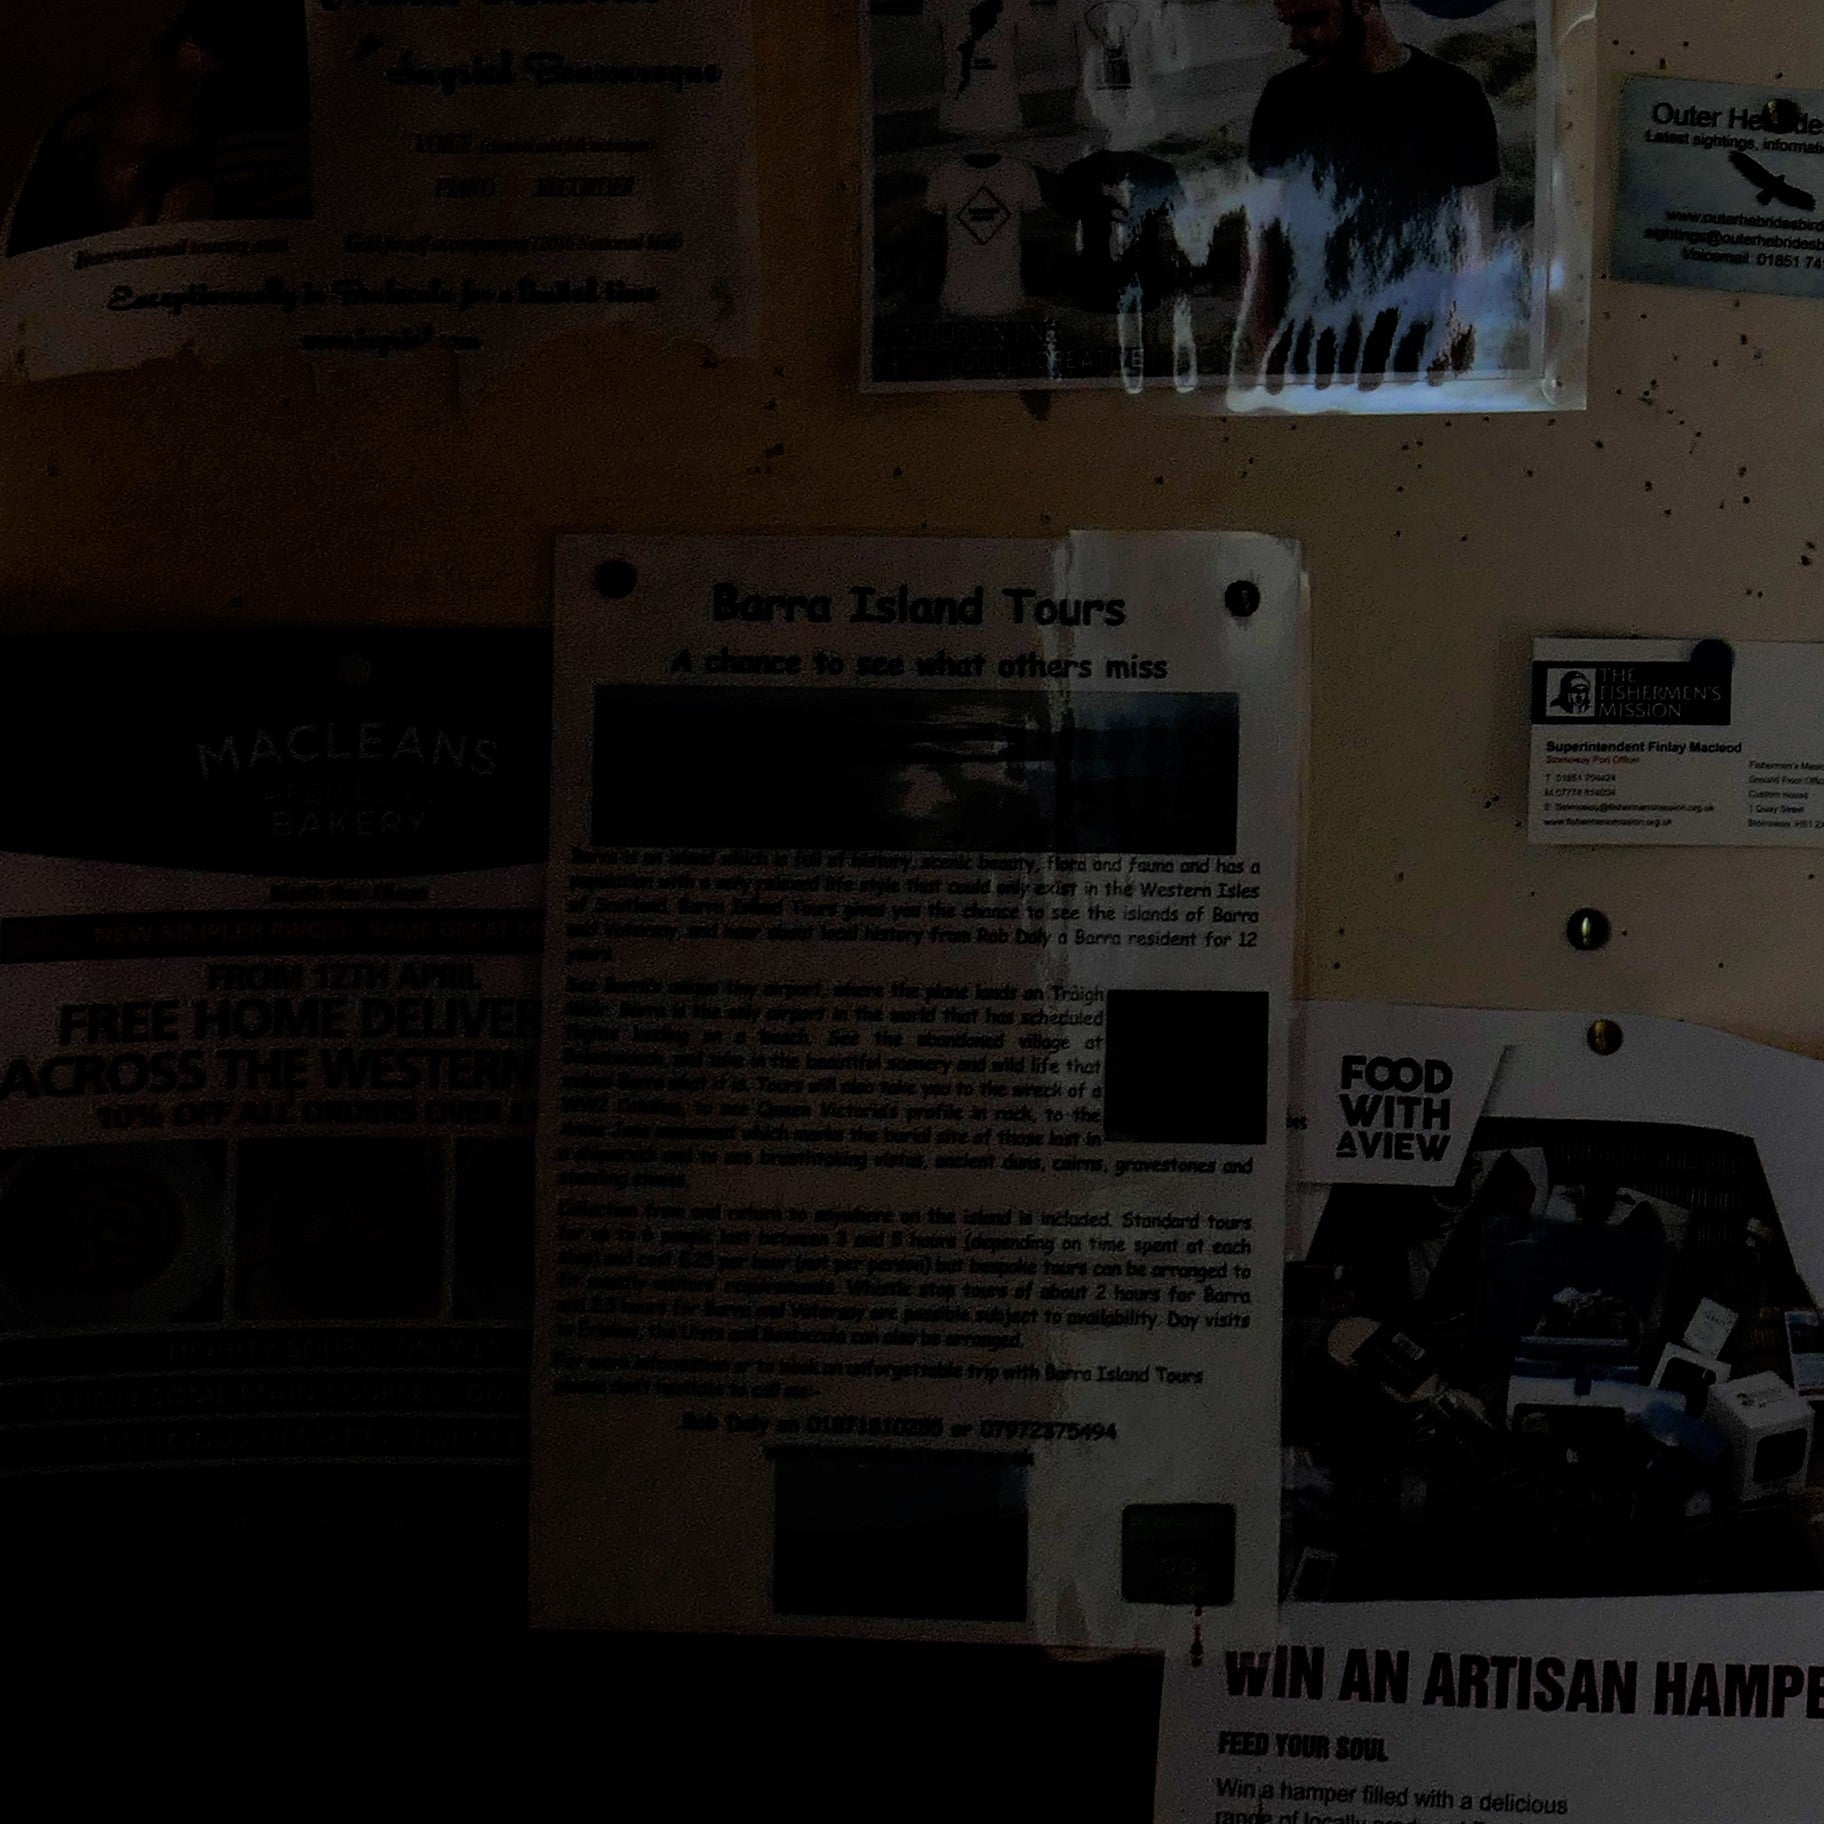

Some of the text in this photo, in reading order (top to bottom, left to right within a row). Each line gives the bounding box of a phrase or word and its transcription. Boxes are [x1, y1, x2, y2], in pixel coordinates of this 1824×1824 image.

[1653, 102, 1722, 129] Outer
[1646, 130, 1689, 145] Latest
[1693, 134, 1758, 153] sightings,
[435, 177, 496, 197] PIANO
[1756, 253, 1800, 269] 01851
[713, 582, 1126, 627] Barra Island Tours
[671, 649, 1168, 680] A chance to see what others miss
[1600, 667, 1637, 683] THE
[1599, 684, 1723, 701] FISHERMEN'S
[1599, 702, 1682, 719] MISSION
[195, 719, 500, 779] MACLEANS
[1546, 741, 1742, 754] Superintendent Finlay Macleod
[269, 808, 428, 839] BAKERY
[1140, 882, 1260, 899] Western Isles
[1123, 906, 1260, 923] islands of Barra
[1128, 931, 1258, 947] resident for 12
[208, 962, 481, 990] FROM 12TH APRIL
[60, 1000, 179, 1045] FREE
[193, 997, 348, 1039] HOME
[0, 1047, 534, 1099] ACROSS THE WESTERN
[1341, 1056, 1452, 1093] FOOD
[98, 1099, 498, 1128] 10% OFF ALL ORDERS OVER
[1339, 1095, 1450, 1130] WITH
[1115, 1158, 1253, 1176] gravestones and
[1122, 1212, 1252, 1230] Standard tours
[1168, 1313, 1250, 1330] Day visits
[1226, 1645, 1325, 1700] WIN
[1339, 1648, 1409, 1705] AN
[1423, 1652, 1638, 1714] ARTISAN
[1218, 1730, 1389, 1762] FEED YOUR SOUL
[1216, 1778, 1569, 1816] Win a hamper filled with a delicious
